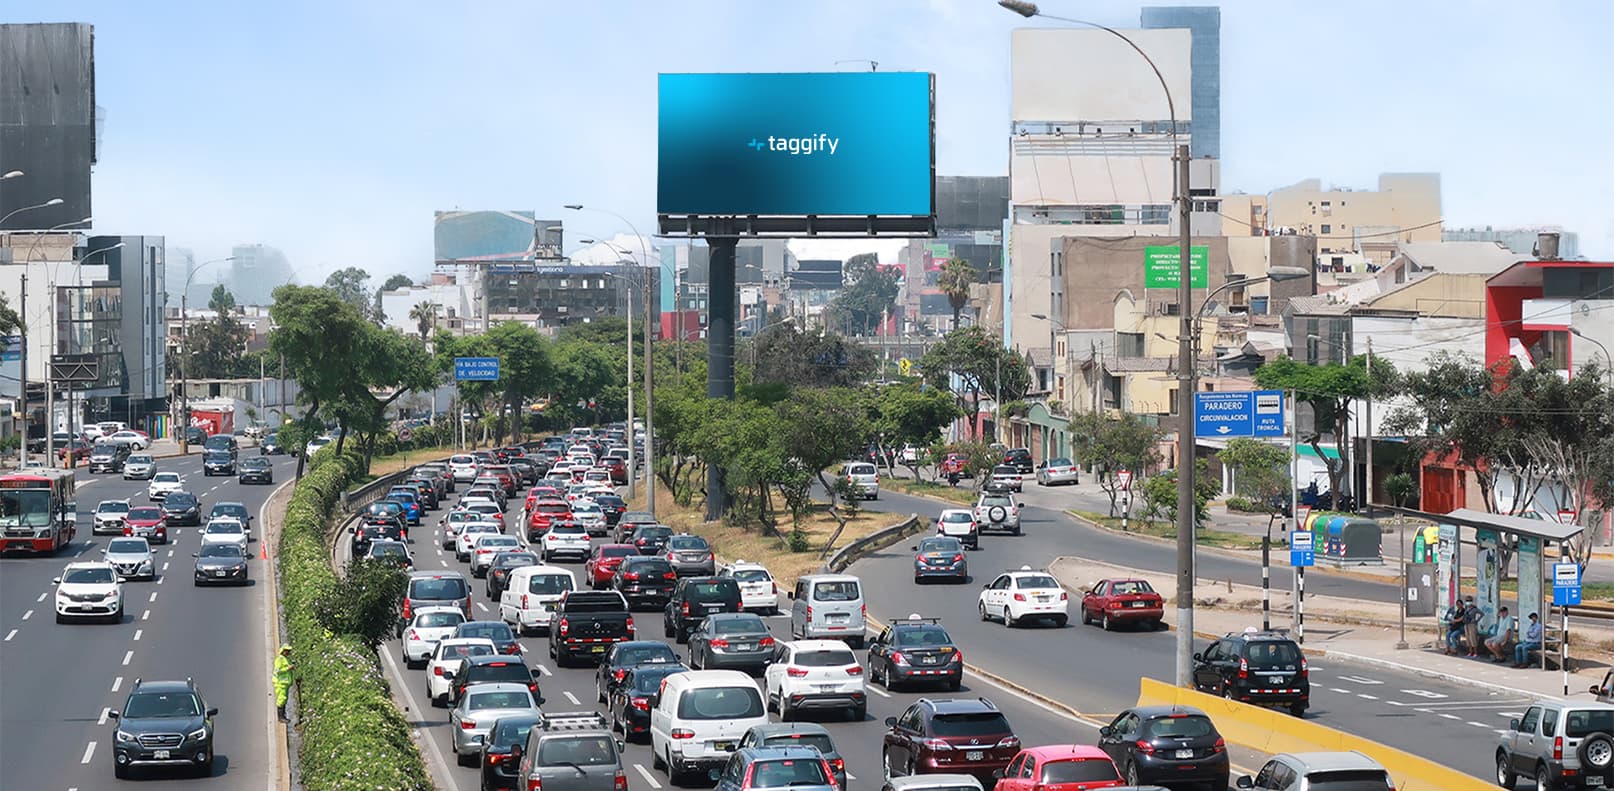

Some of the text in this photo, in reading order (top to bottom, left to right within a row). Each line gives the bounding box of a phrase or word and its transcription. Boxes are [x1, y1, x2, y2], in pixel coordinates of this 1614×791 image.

[768, 133, 839, 155] taggify
[1204, 402, 1243, 410] PARADERO
[1200, 414, 1248, 422] CIRCUNVALACION
